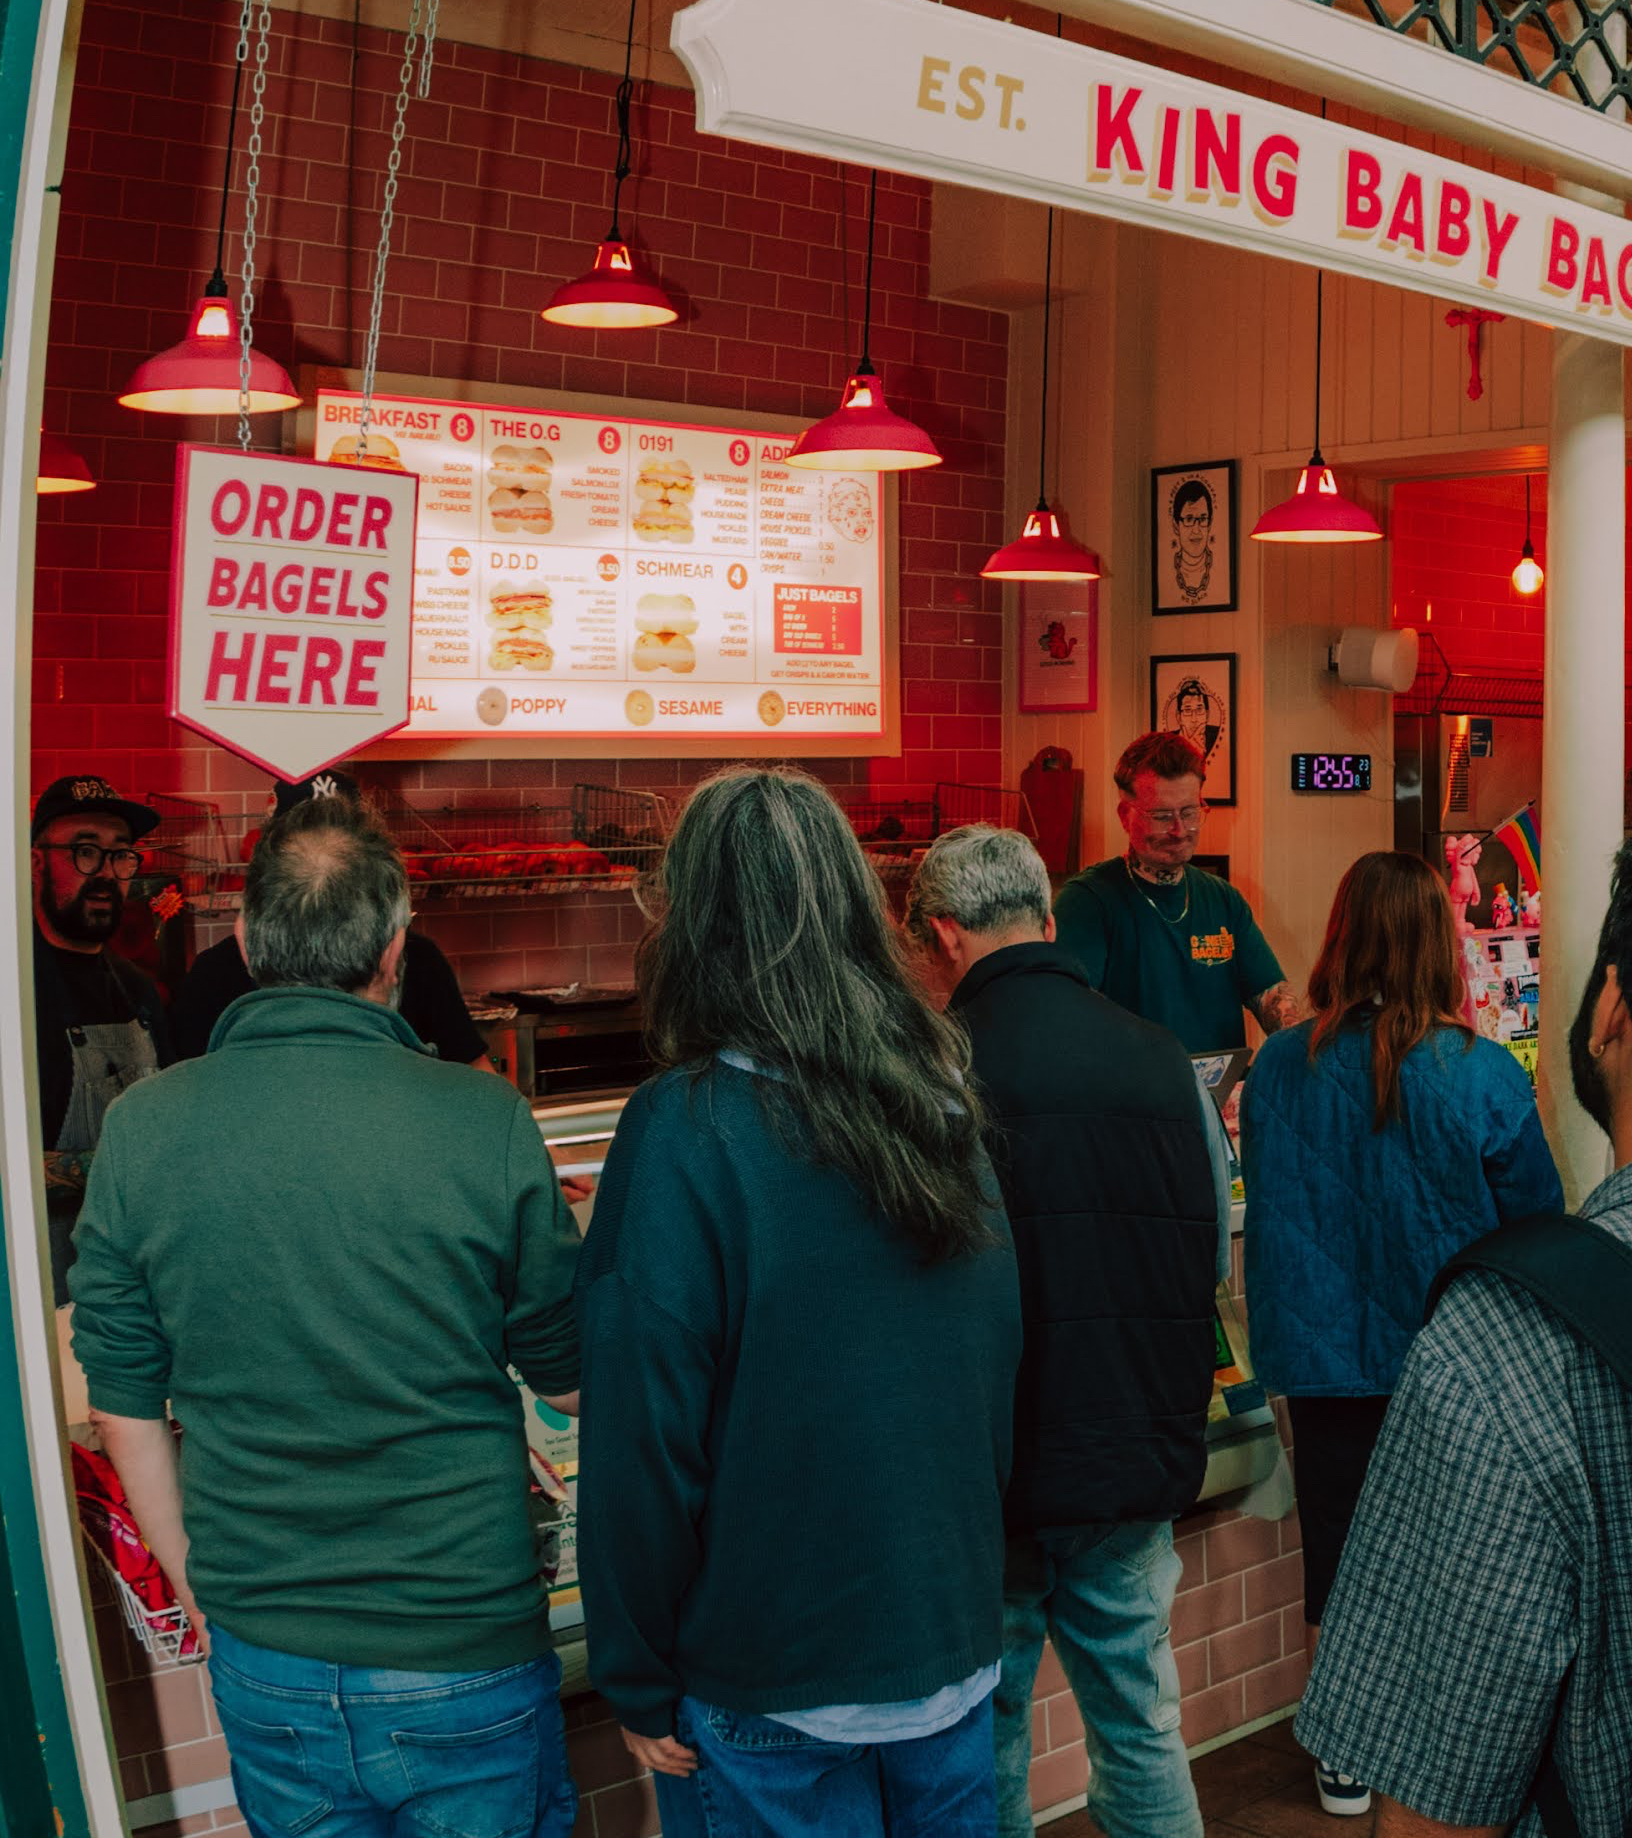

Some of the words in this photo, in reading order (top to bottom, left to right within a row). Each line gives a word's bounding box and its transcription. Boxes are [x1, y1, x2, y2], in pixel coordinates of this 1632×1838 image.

[916, 56, 1026, 132] EST.
[1087, 82, 1300, 226] KING
[1337, 147, 1519, 288] BABY
[324, 405, 441, 430] BREAKFAST
[455, 418, 469, 438] 8
[490, 419, 526, 438] THE
[530, 422, 560, 441] O.G
[603, 430, 615, 449] 8
[639, 434, 673, 452] 0191
[734, 443, 745, 461] 8
[211, 479, 393, 550] ORDER
[207, 557, 390, 619] BAGELS
[636, 560, 713, 578] SCHMEAR
[731, 567, 742, 585] 4
[777, 587, 808, 601] JUST
[809, 589, 858, 604] BAGELS
[204, 631, 387, 707] HERE
[511, 698, 567, 714] POPPY
[658, 700, 723, 716] SESAME
[786, 701, 877, 717] EVERYTHING
